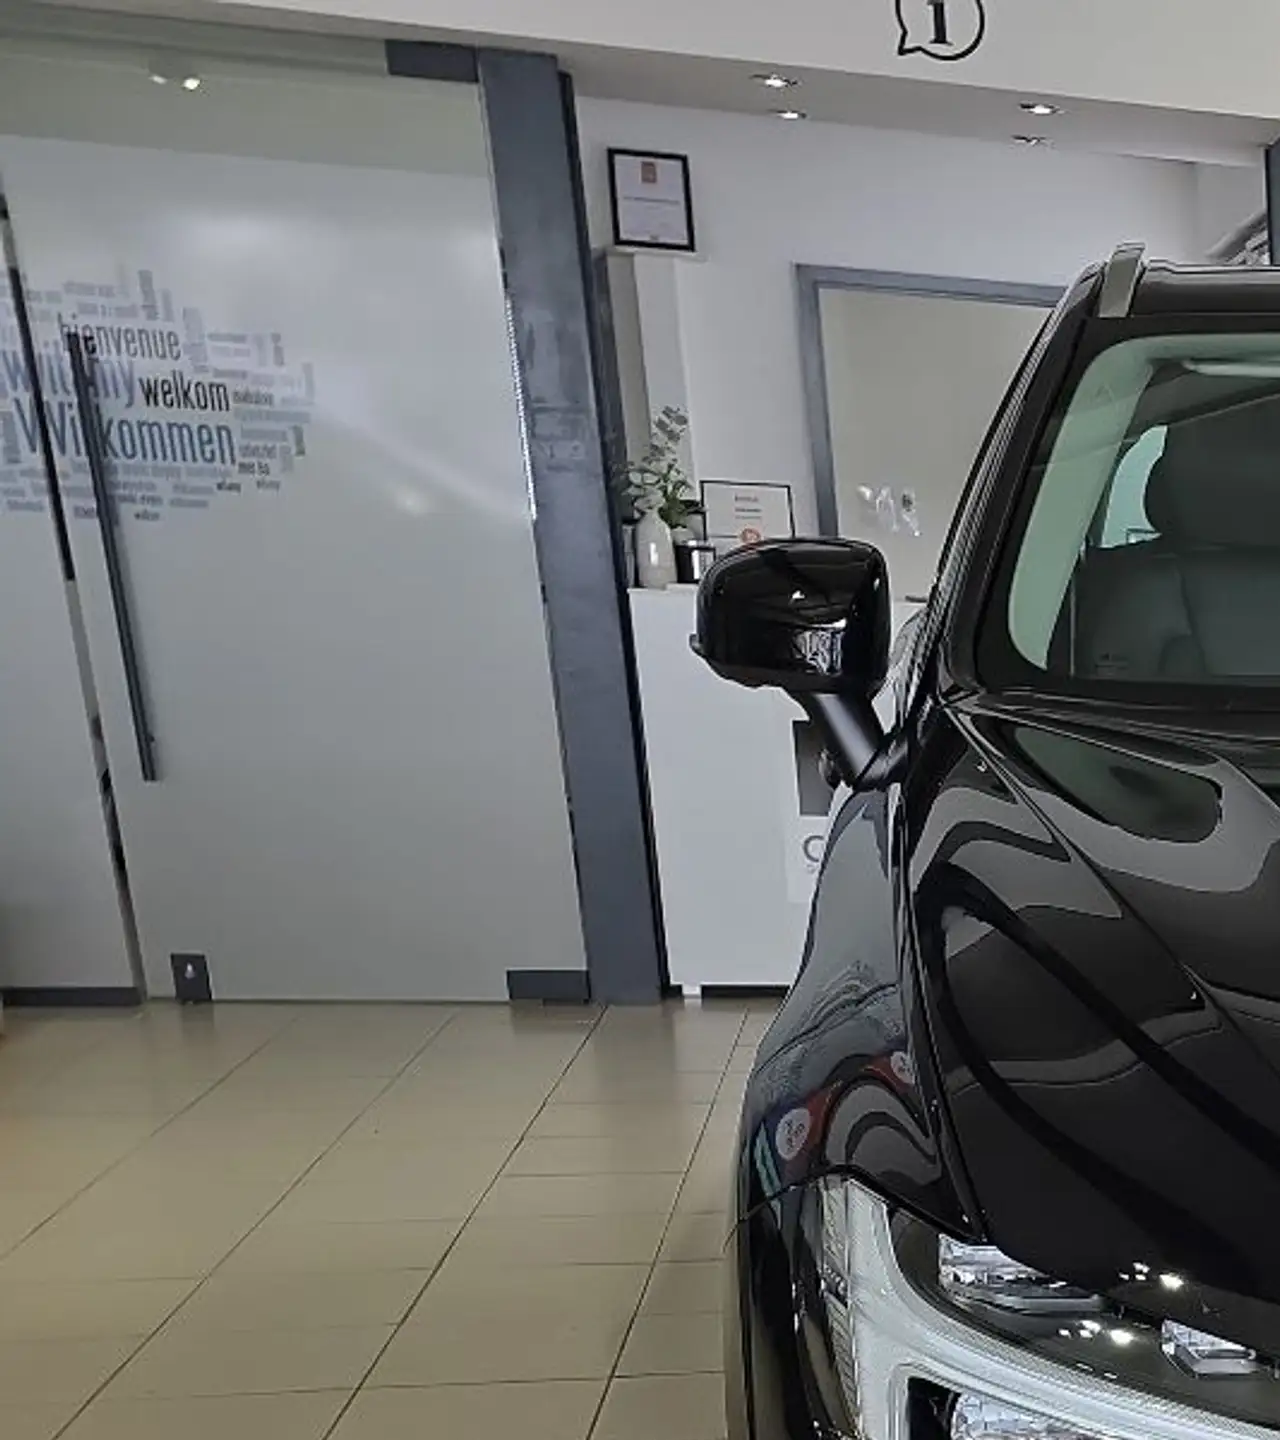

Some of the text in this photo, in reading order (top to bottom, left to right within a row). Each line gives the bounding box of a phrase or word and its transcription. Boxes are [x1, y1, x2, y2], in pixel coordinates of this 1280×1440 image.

[2, 338, 135, 409] witmy
[139, 370, 230, 412] welkom
[13, 397, 237, 465] Wilkommen
